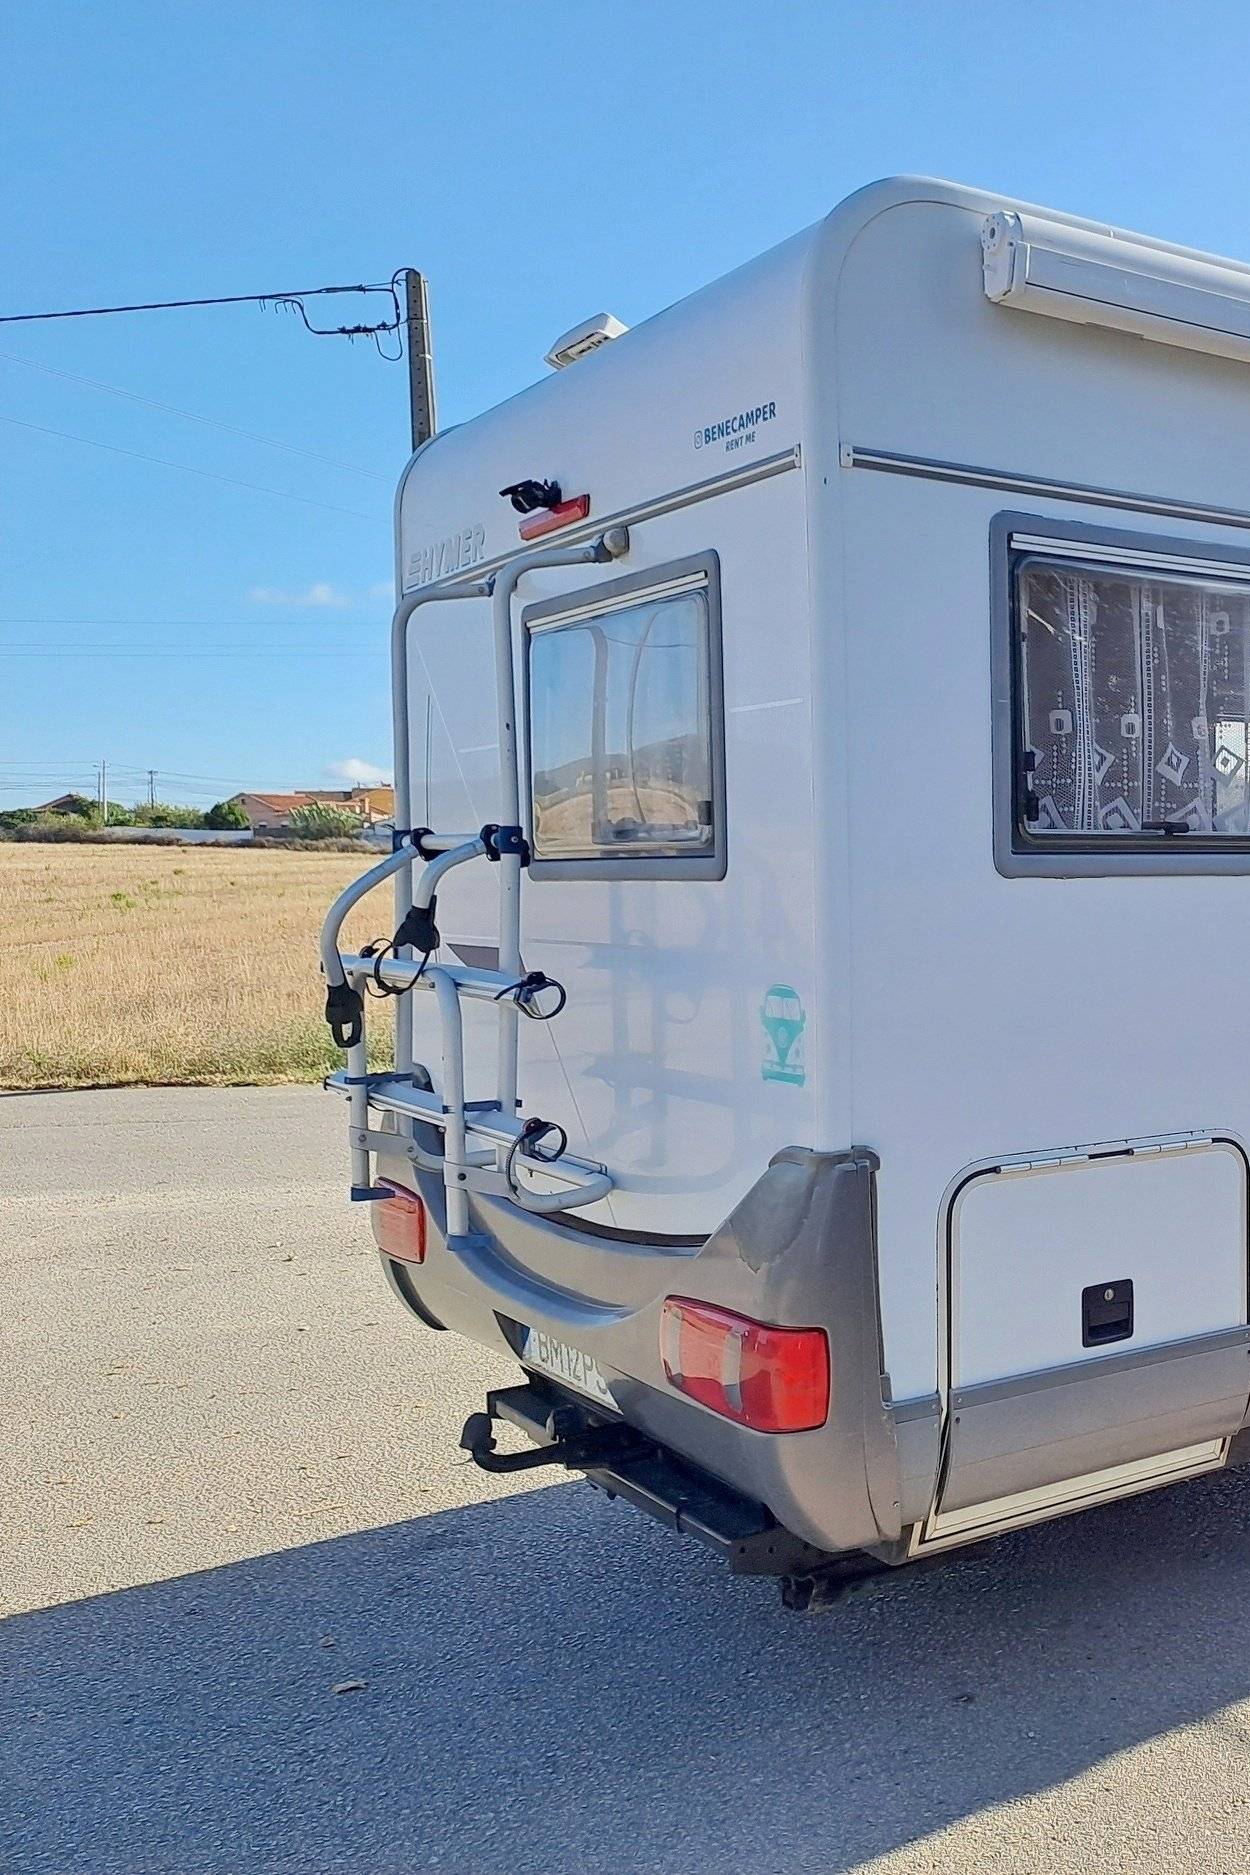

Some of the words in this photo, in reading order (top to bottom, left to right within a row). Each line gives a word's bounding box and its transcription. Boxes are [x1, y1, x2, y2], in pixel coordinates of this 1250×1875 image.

[704, 402, 776, 445] BENECAMPER
[725, 435, 744, 452] RENT
[744, 431, 756, 445] ME
[420, 520, 487, 584] HYMER
